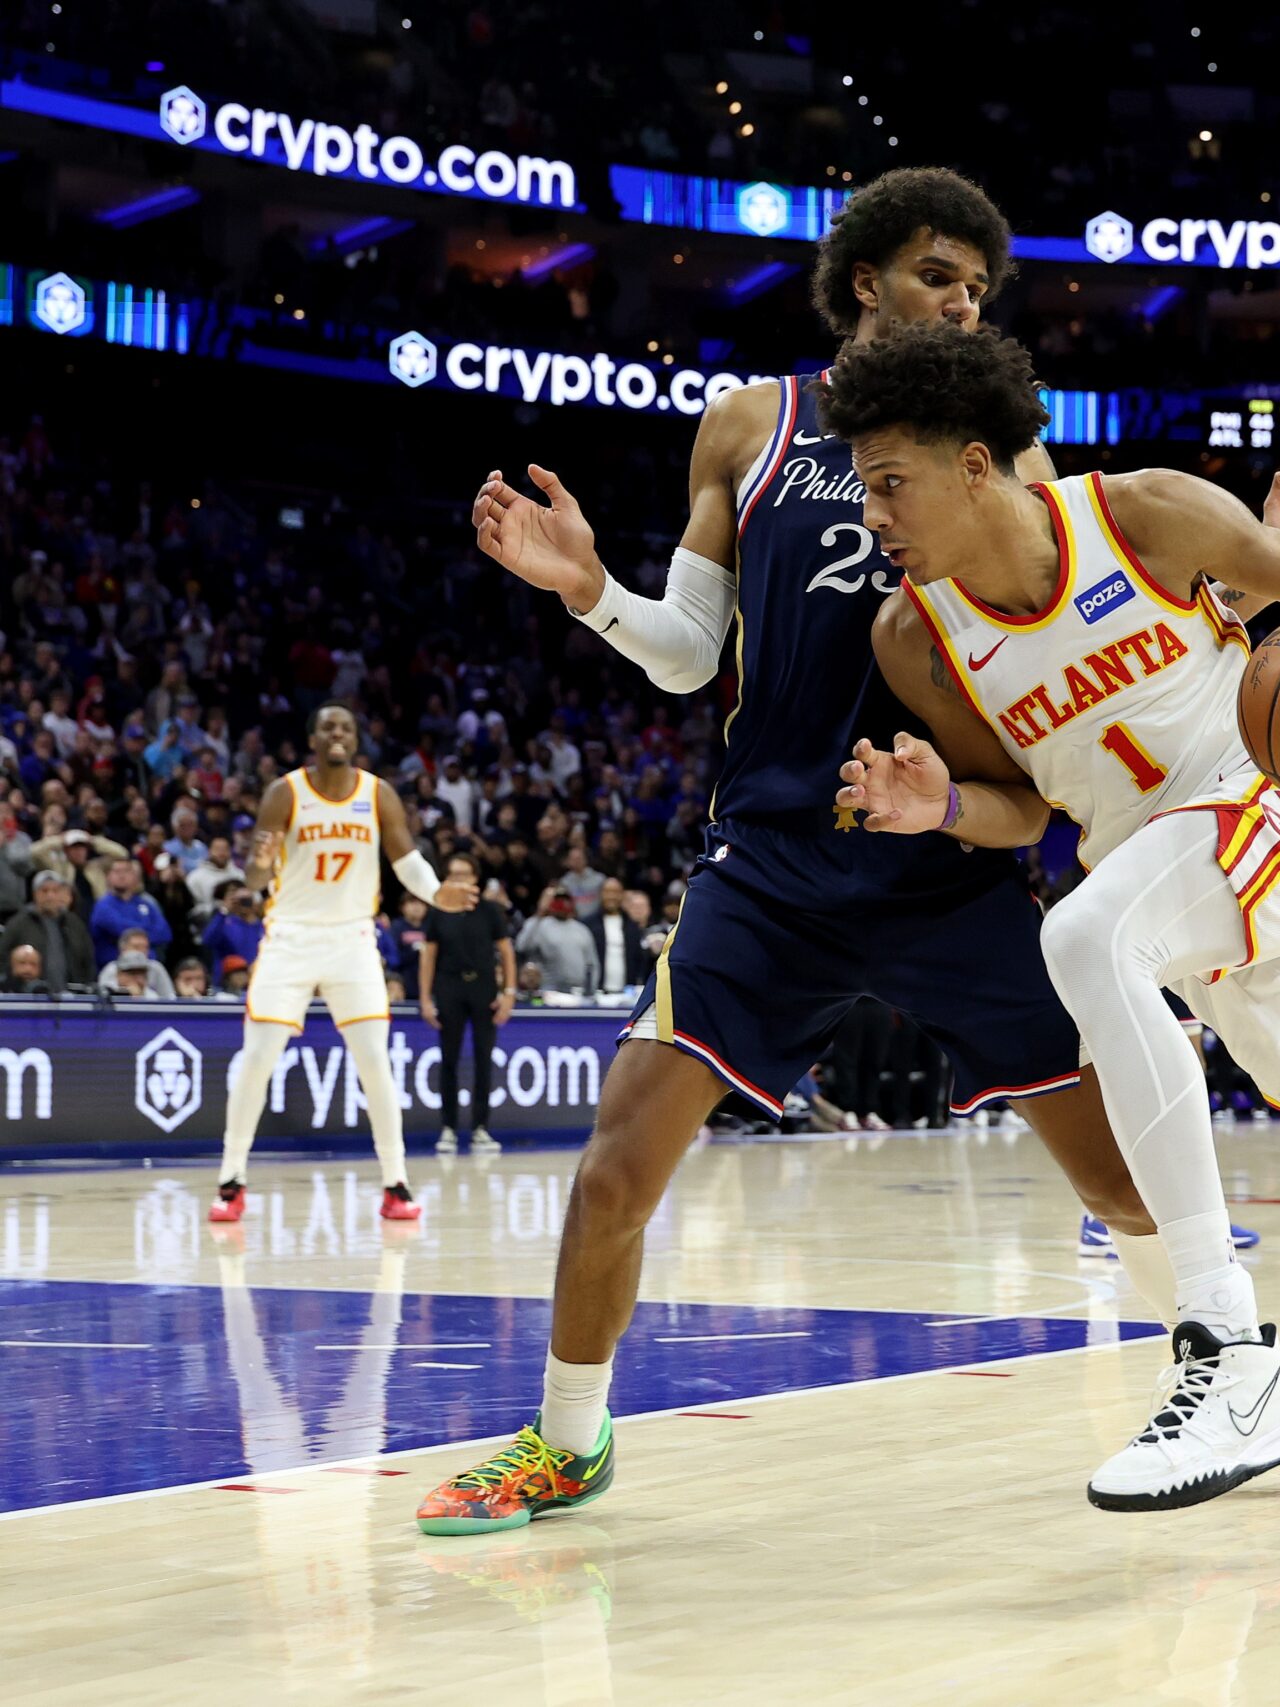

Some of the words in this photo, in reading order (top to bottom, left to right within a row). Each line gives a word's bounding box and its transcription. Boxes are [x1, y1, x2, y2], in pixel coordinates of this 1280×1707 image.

[214, 102, 577, 207] crypto.com
[446, 343, 780, 415] crypto.c
[1080, 580, 1127, 618] paze
[998, 620, 1190, 750] ATLANTA
[1099, 720, 1168, 795] 1
[296, 822, 372, 844] ATLANTA
[314, 852, 354, 882] 17
[227, 1031, 600, 1128] rypto.om
